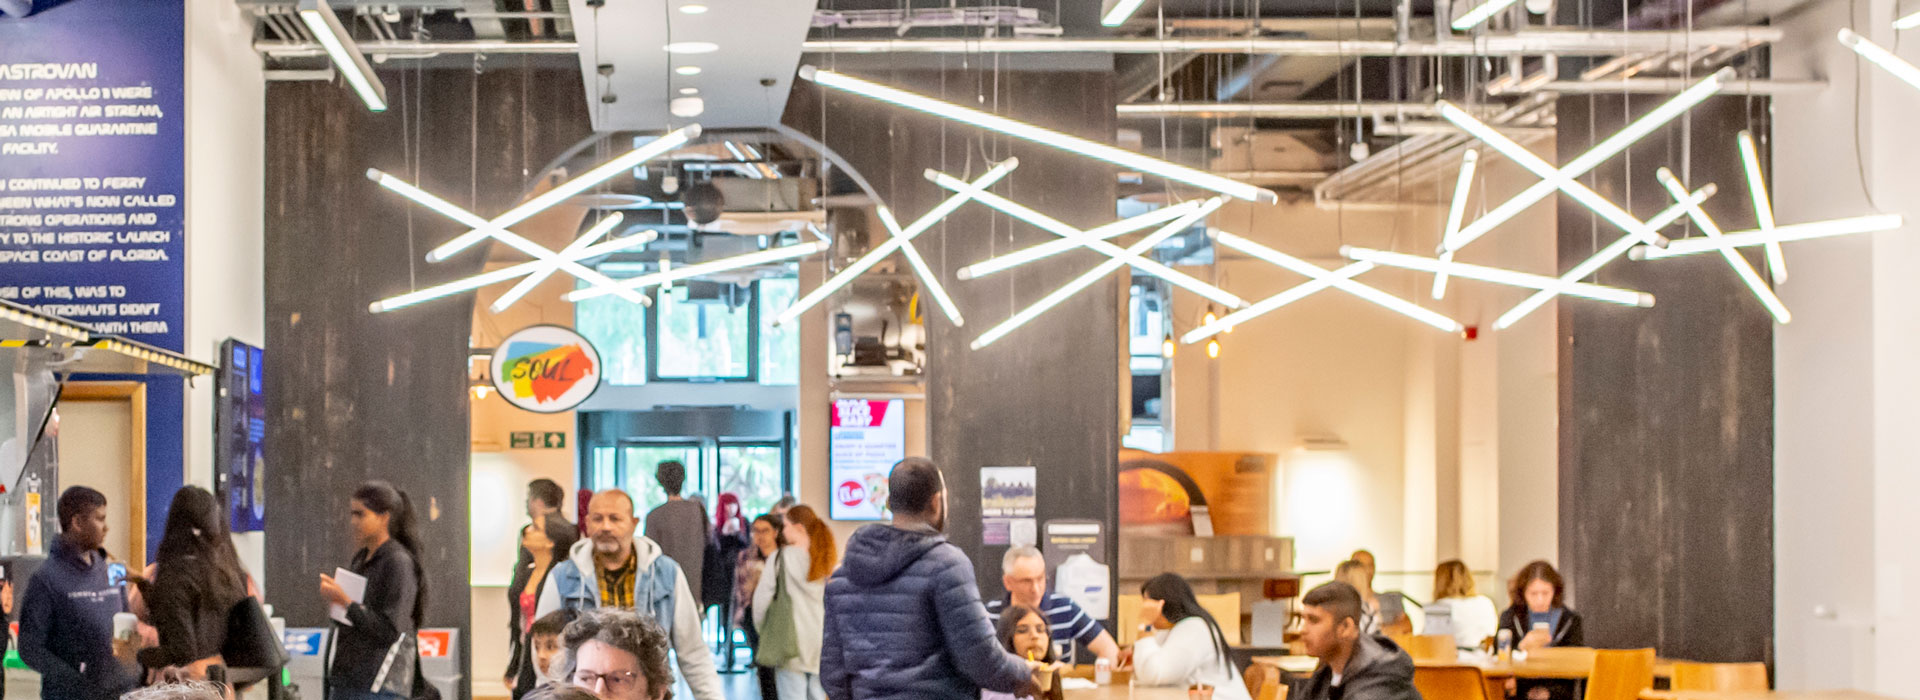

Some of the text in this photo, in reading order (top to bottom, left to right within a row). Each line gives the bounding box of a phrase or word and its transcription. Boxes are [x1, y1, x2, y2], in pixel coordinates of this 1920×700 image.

[0, 62, 97, 80] ASTROVAN
[24, 88, 43, 101] OF
[45, 87, 101, 101] APOLLO
[112, 86, 153, 99] WERE
[2, 104, 164, 119] AN AIRTIGHT AIR STREAM,
[20, 123, 73, 137] MOBILE
[74, 122, 158, 136] QUARANTINE
[3, 142, 59, 155] FACILITY.
[8, 177, 82, 191] CONTINUED
[83, 177, 101, 190] TO
[103, 176, 147, 190] FERRY
[33, 195, 84, 208] WHAT'S
[86, 195, 121, 208] NOW
[123, 194, 176, 208] CALLED
[45, 213, 127, 226] OPERATIONS
[128, 212, 157, 225] AND
[13, 232, 29, 245] TO
[31, 232, 56, 245] THE
[58, 231, 114, 244] HISTORIC
[117, 230, 171, 243] LAUNCH
[42, 249, 85, 262] COAST
[88, 249, 108, 262] OF
[22, 286, 42, 299] OF
[75, 285, 108, 298] WAS
[109, 285, 126, 298] TO
[97, 321, 128, 334] WITH
[130, 320, 168, 334] THEM
[512, 356, 574, 382] SOUL
